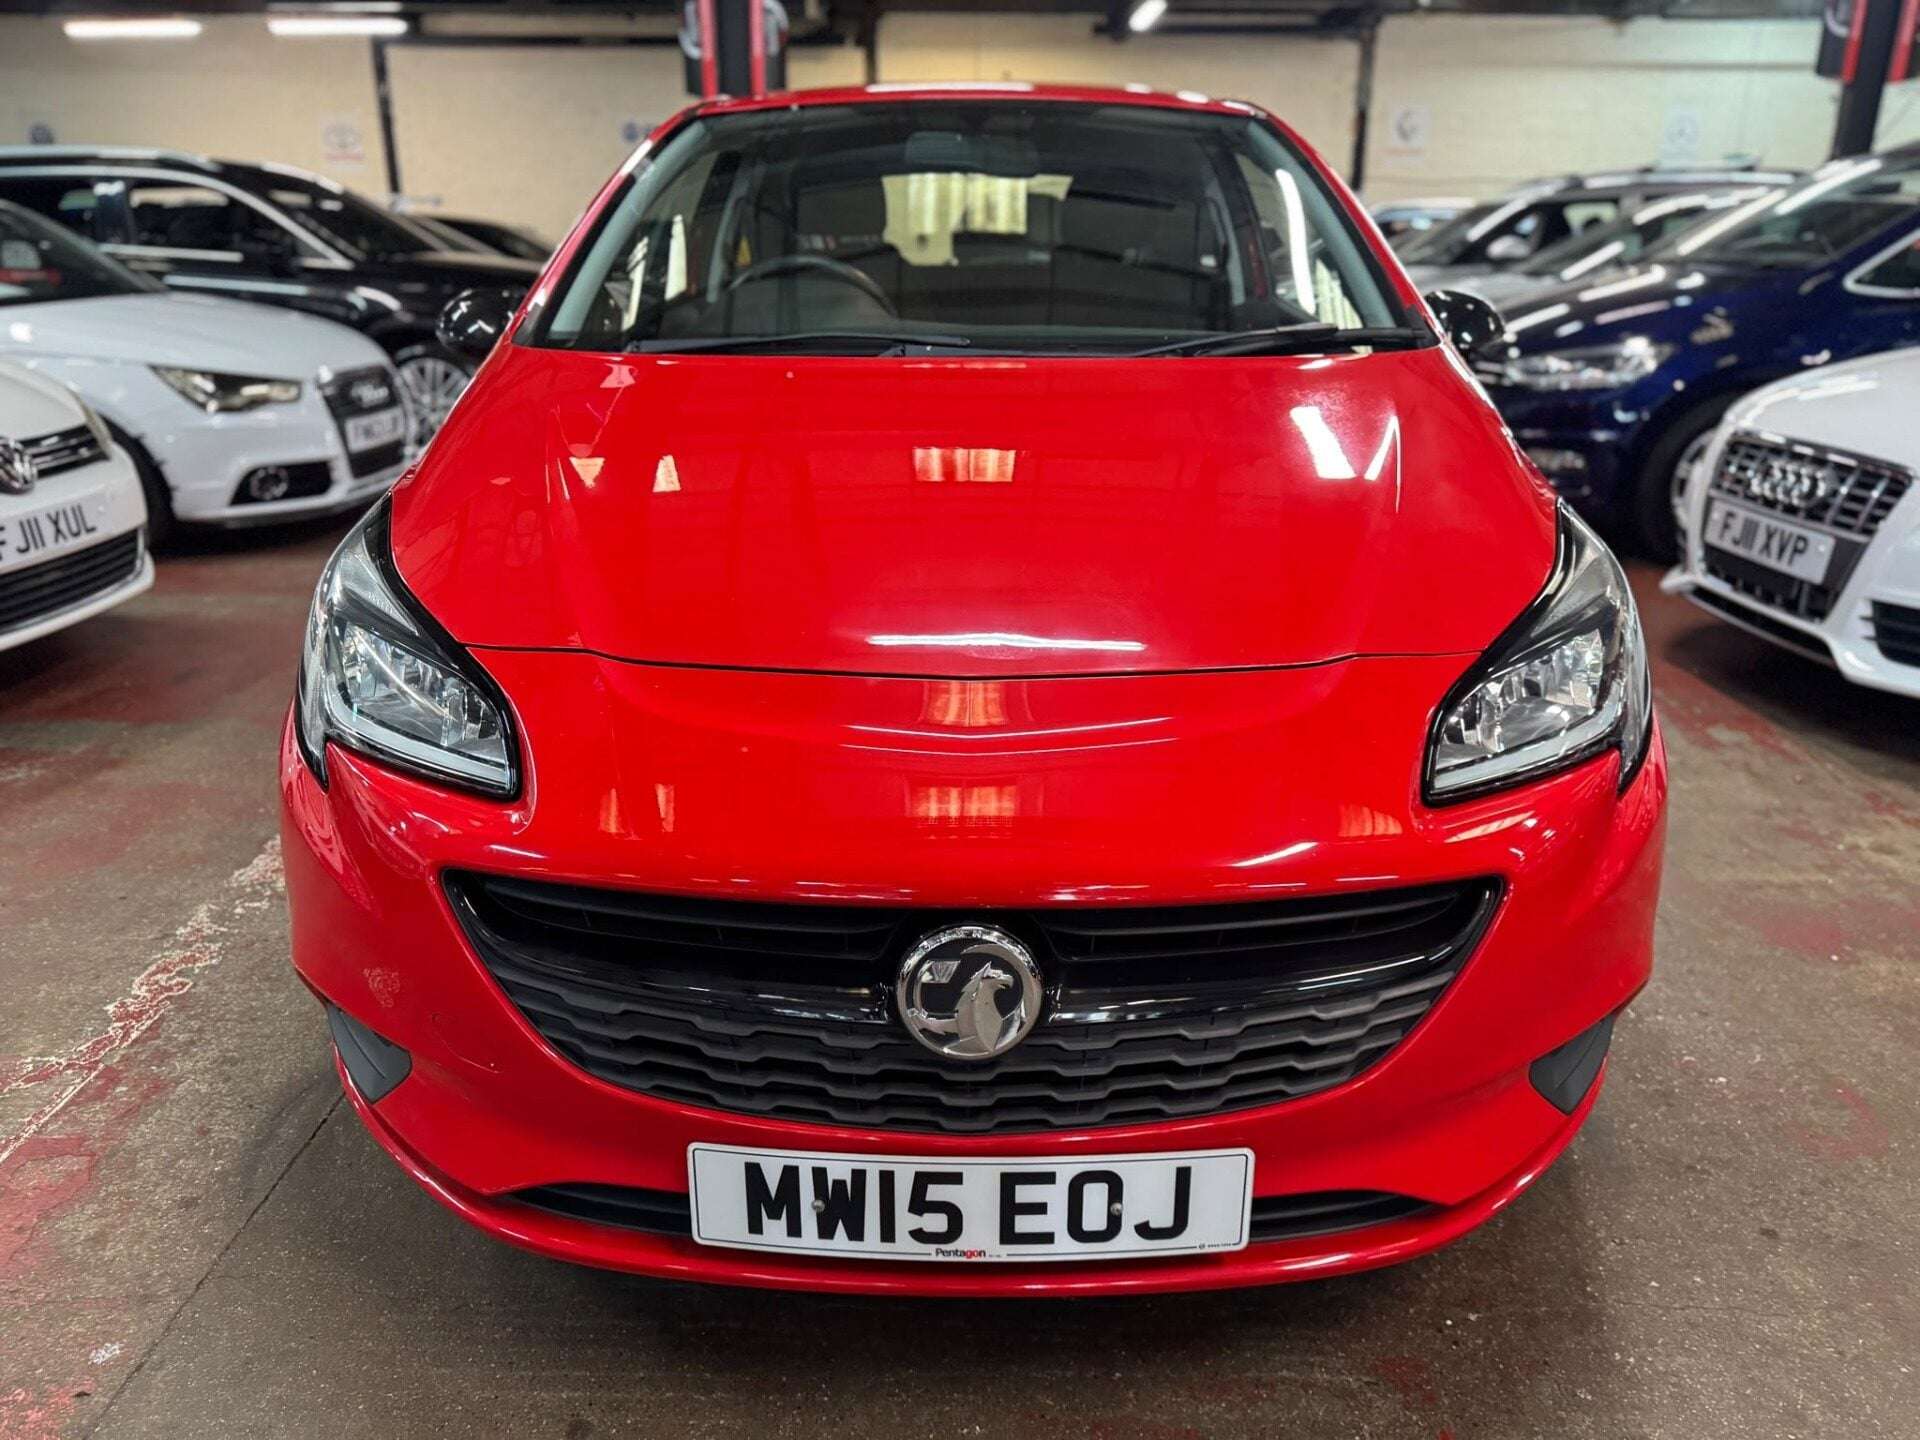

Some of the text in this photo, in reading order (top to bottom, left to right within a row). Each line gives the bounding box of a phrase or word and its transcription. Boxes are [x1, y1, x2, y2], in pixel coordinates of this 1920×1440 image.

[46, 503, 97, 543] XUL
[1719, 510, 1809, 566] FJ11 XVP
[744, 1161, 1192, 1245] MW15 EOJ
[935, 1248, 986, 1259] Pentagon
